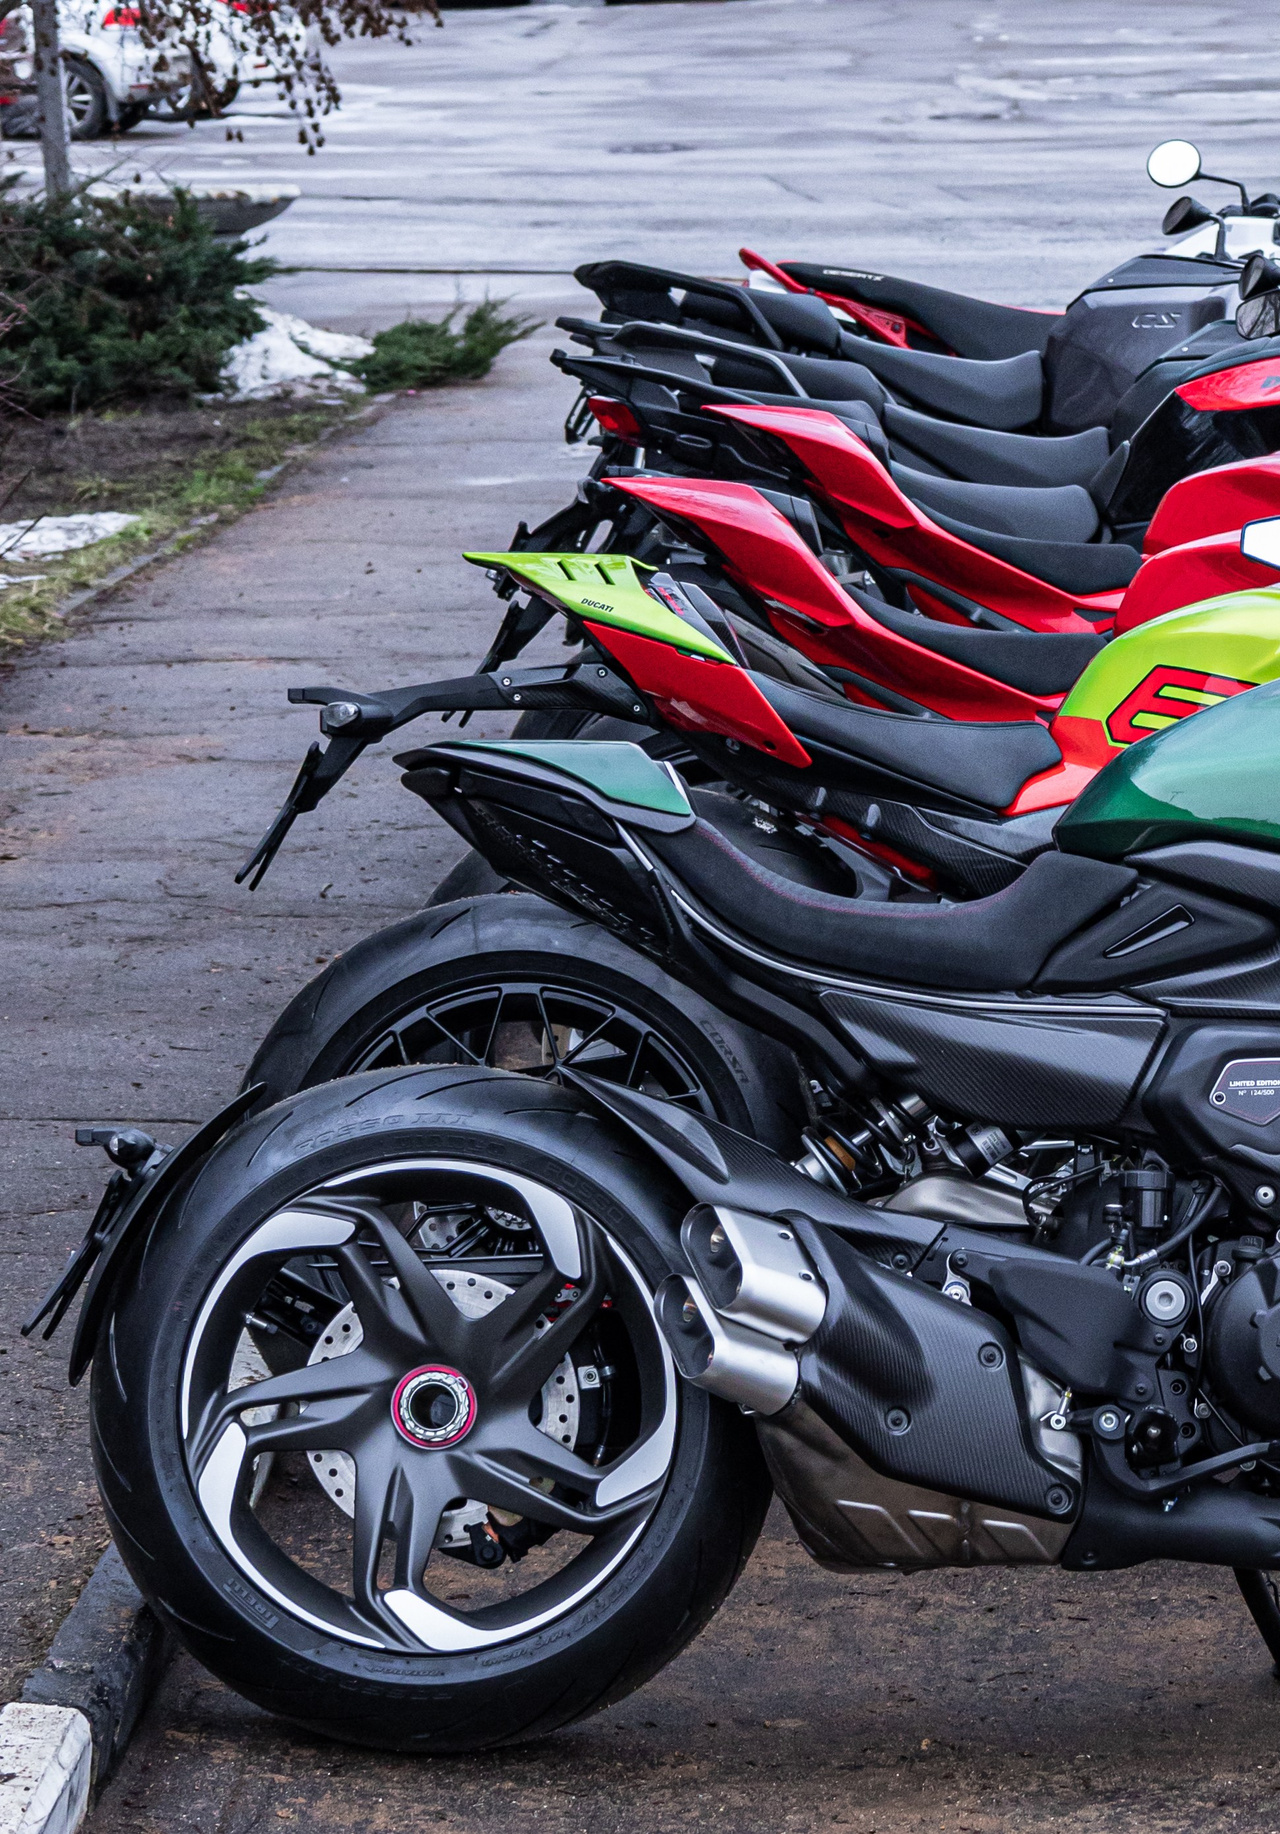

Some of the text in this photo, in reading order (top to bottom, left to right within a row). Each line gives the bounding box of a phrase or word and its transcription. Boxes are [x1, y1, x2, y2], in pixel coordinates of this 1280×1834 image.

[581, 598, 614, 613] DUCATI
[700, 1020, 750, 1084] CORSA
[223, 1578, 279, 1630] PIRELLI
